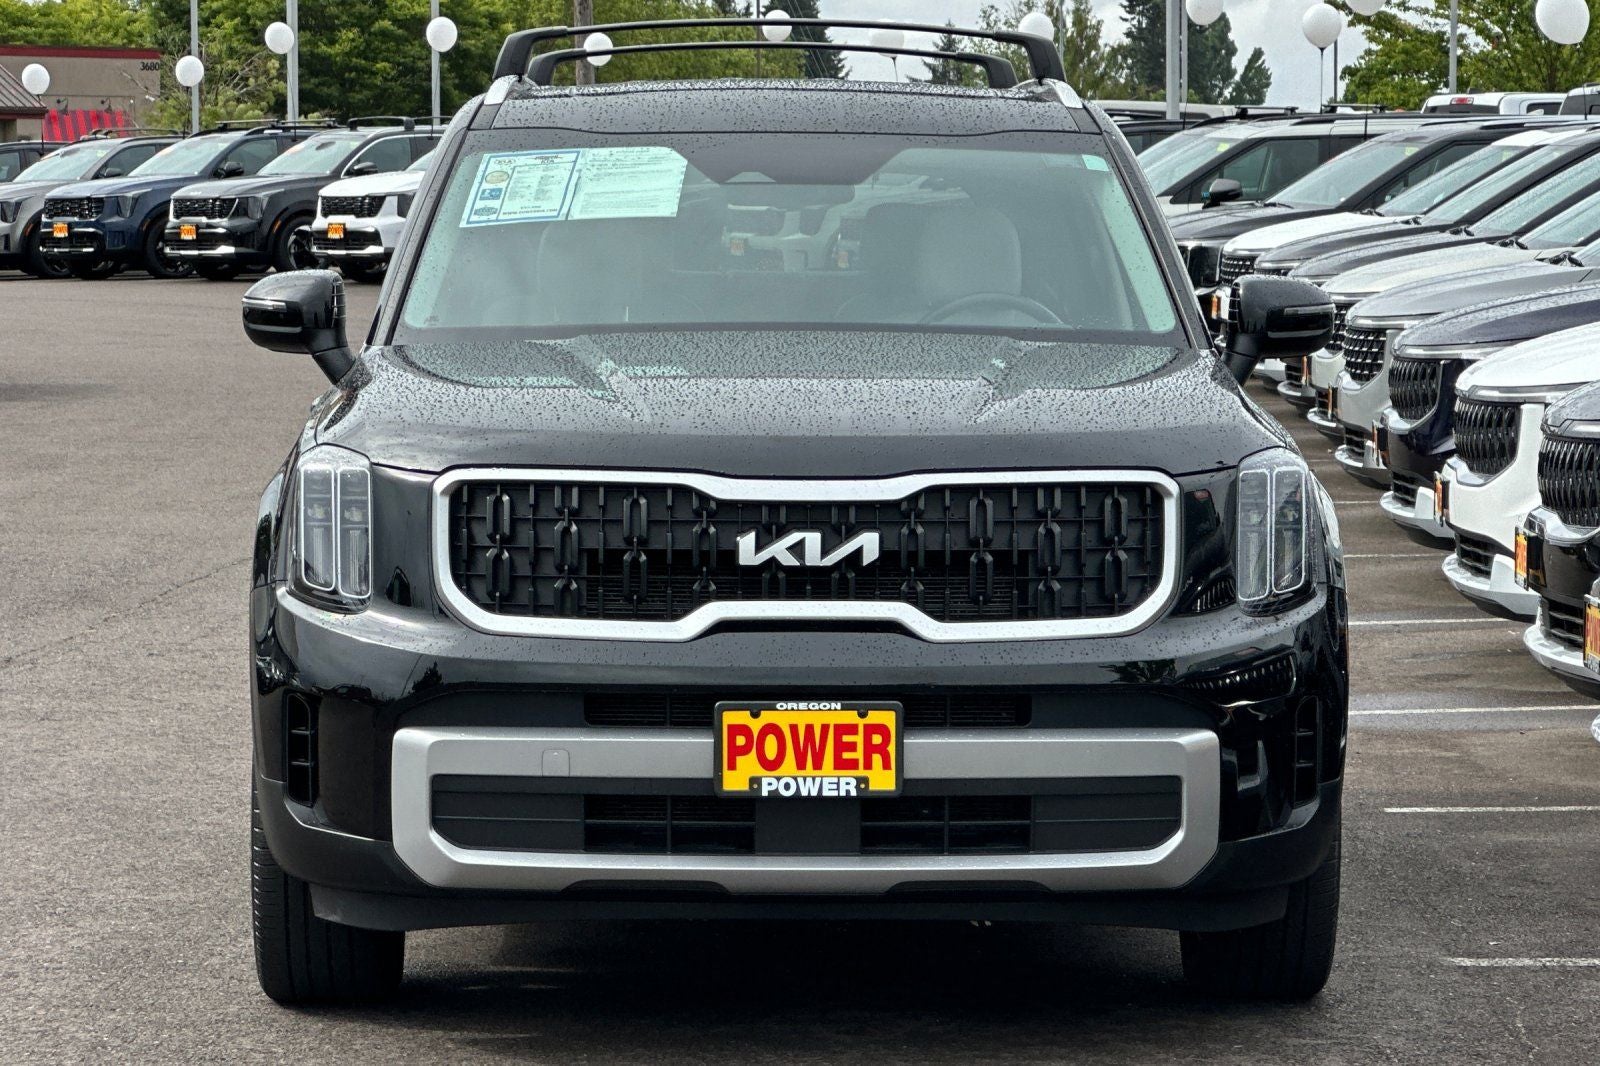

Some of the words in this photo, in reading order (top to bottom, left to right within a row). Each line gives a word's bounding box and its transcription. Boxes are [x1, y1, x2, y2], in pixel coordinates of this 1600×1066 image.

[140, 61, 160, 71] 3680
[736, 529, 880, 567] KIA
[776, 702, 842, 711] OREGON
[726, 722, 893, 772] POWER
[761, 776, 857, 797] POWER
